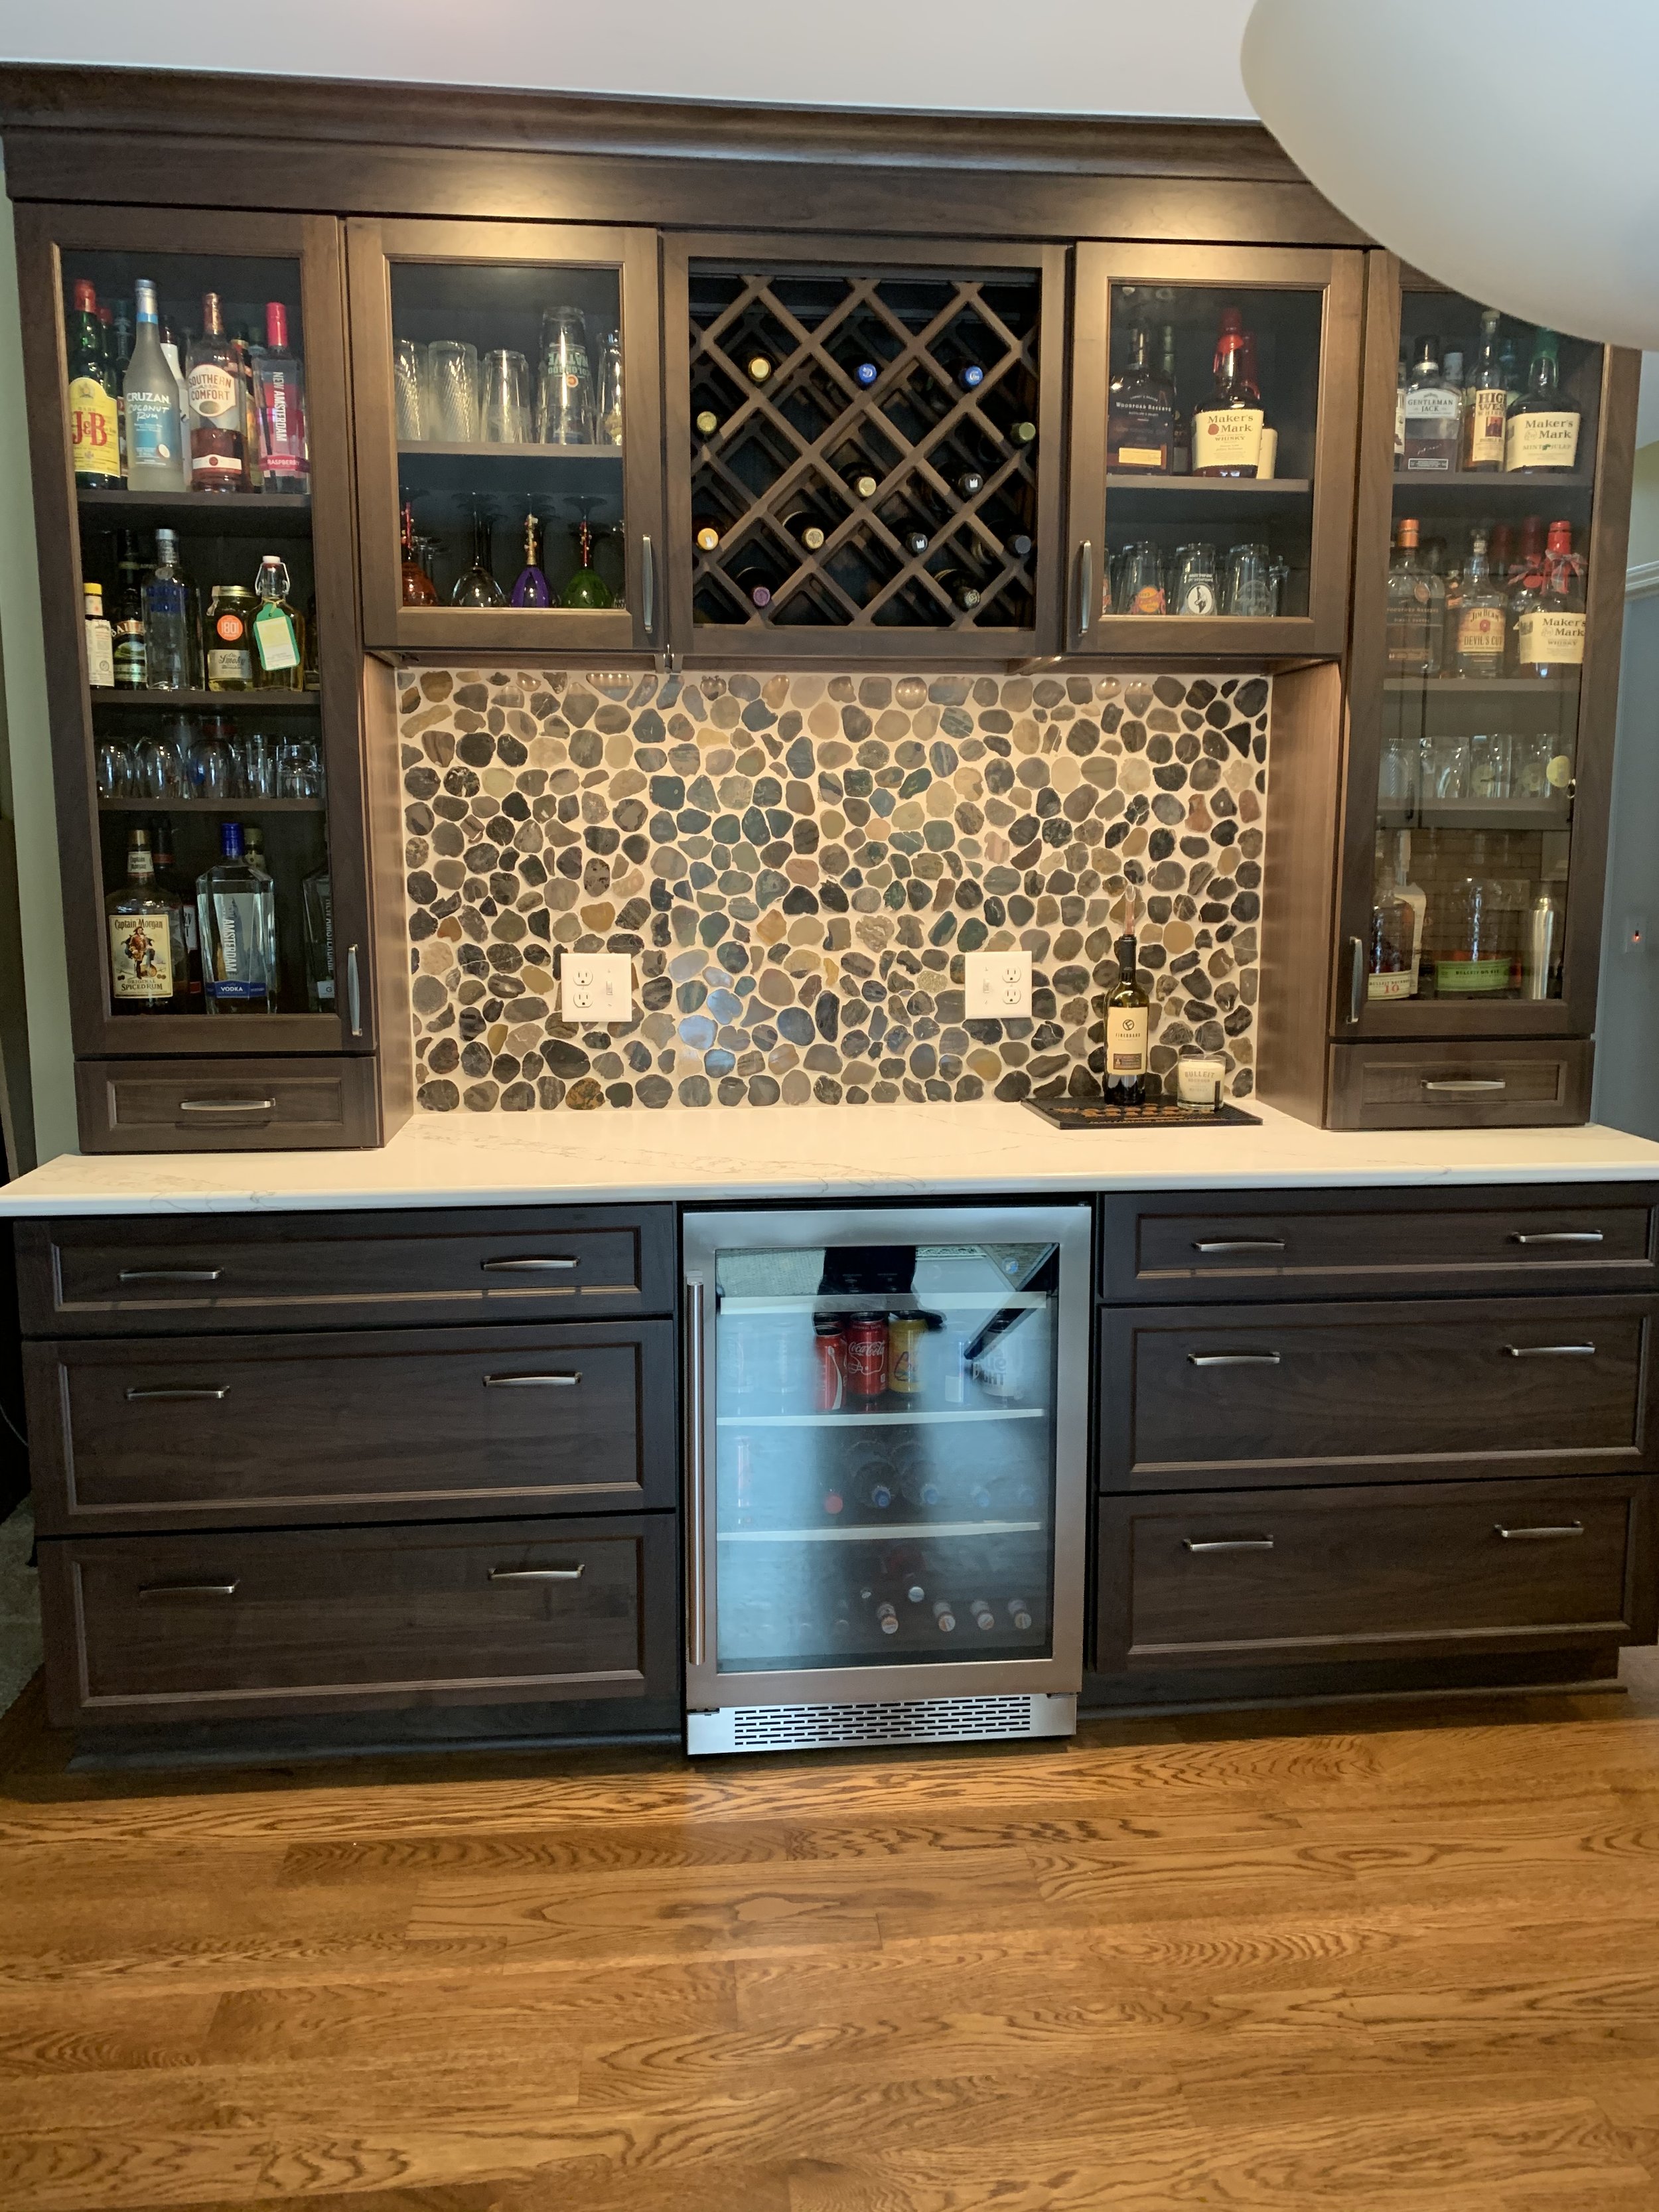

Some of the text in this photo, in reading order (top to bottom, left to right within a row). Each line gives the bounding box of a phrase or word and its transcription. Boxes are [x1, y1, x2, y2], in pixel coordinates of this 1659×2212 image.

[188, 374, 232, 388] SOUTHERN
[127, 392, 171, 404] CRUZAN
[191, 390, 230, 400] COMFORT
[128, 404, 170, 413] COCONUT
[273, 372, 287, 441] NEW AMSTERDAM
[1208, 414, 1254, 424] Maker's
[1525, 419, 1573, 429] Maker's
[72, 410, 108, 447] J&B
[1220, 424, 1253, 433] Mark
[1538, 430, 1572, 439] Mark
[1542, 618, 1586, 627] Maker's
[1555, 628, 1585, 637] Mark
[1491, 636, 1503, 646] CUT
[115, 919, 163, 930] Captain Morgan
[223, 919, 238, 972] AMSTERDAM
[121, 983, 146, 992] SPICED
[1384, 984, 1400, 994] 10
